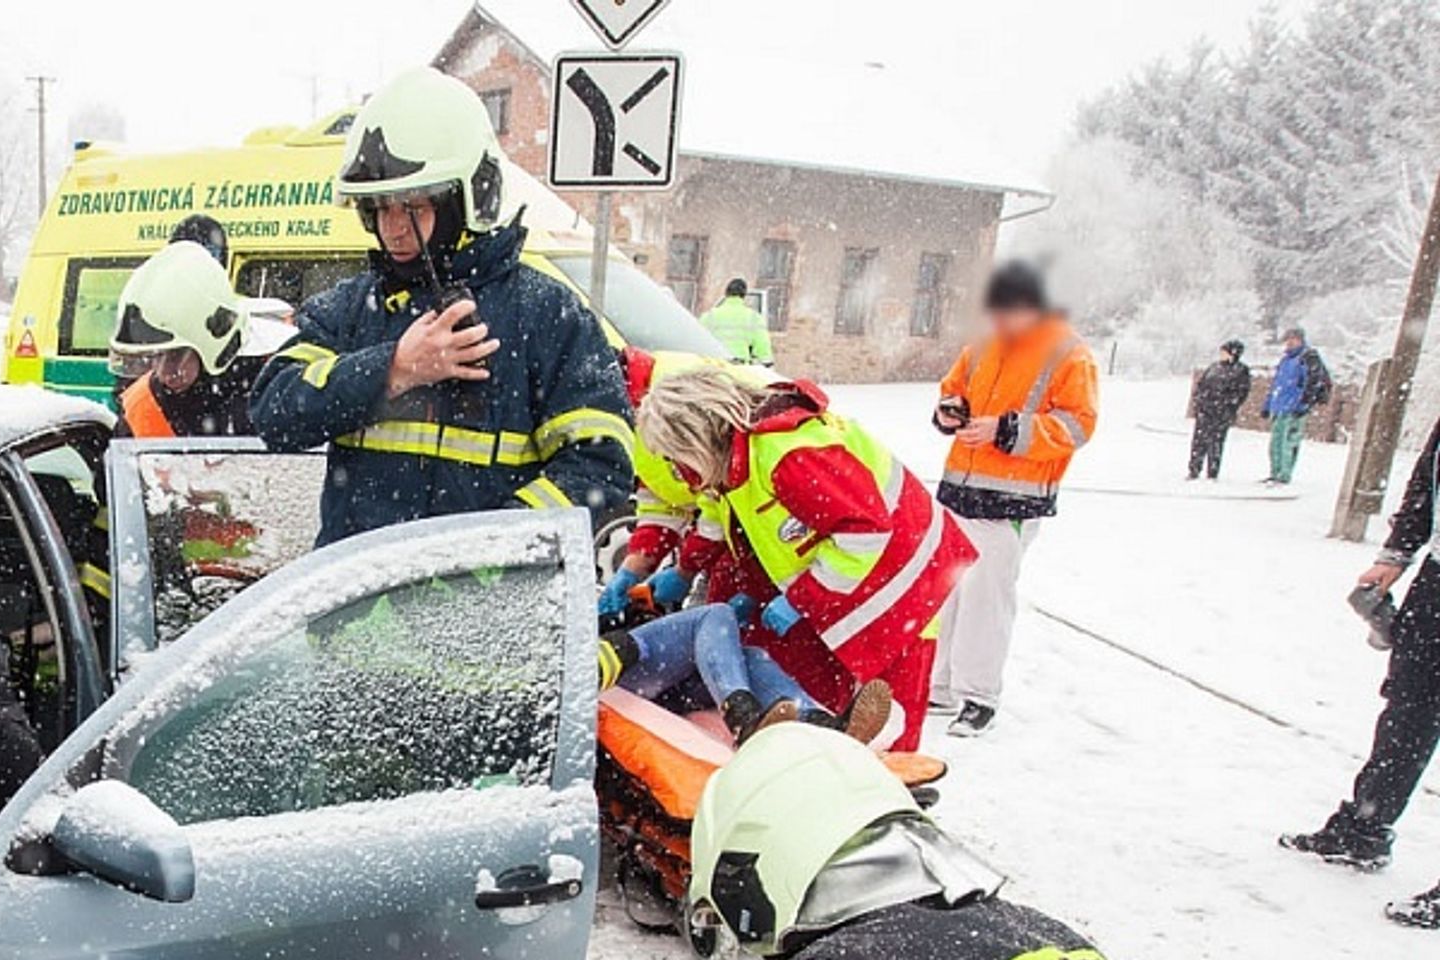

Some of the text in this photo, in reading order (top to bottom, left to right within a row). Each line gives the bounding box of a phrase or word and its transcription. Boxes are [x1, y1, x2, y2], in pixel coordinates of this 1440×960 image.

[58, 176, 334, 216] ZDRAVOTNICKÁ ZÁCHRANNÁ
[285, 218, 332, 237] KRAJE
